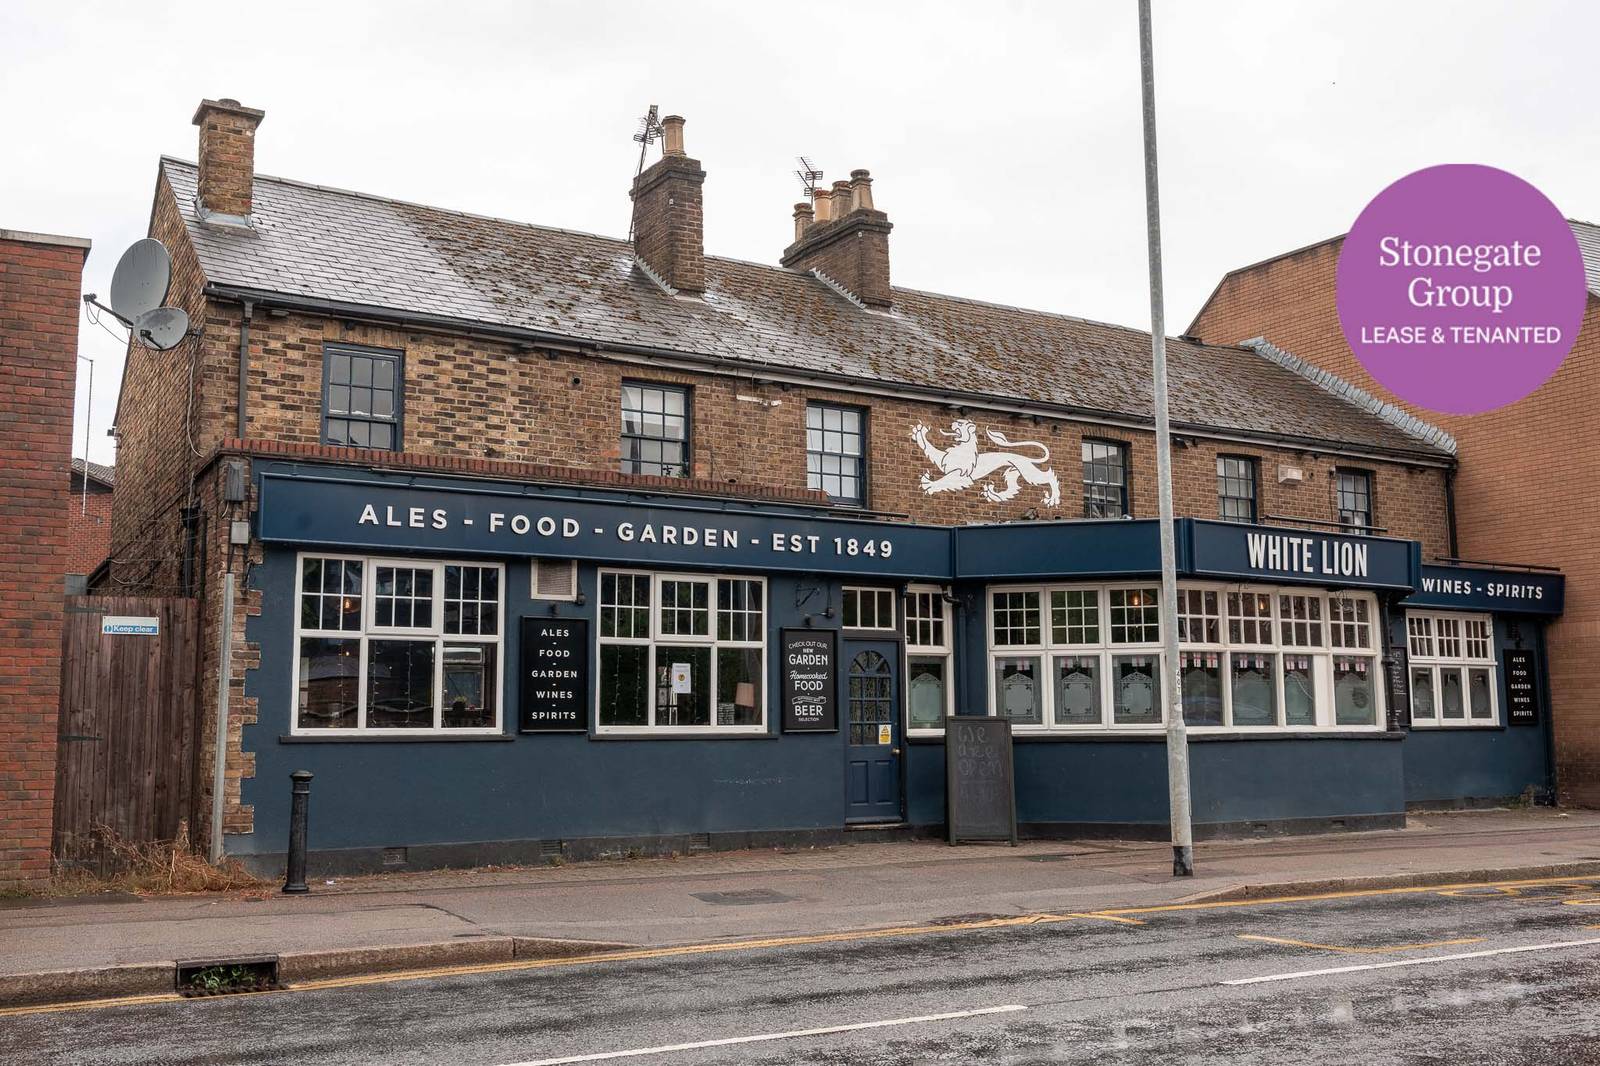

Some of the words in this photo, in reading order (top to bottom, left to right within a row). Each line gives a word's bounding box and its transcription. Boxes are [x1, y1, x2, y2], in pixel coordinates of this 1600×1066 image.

[358, 504, 448, 529] ALES
[489, 513, 580, 537] FOOD
[617, 522, 738, 548] GARDEN
[772, 533, 820, 553] EST
[834, 537, 893, 558] 1849
[1247, 533, 1314, 573] WHITE
[1321, 540, 1368, 577] LION
[1422, 578, 1472, 595] WINES
[1487, 583, 1543, 599] SPIRITS
[113, 625, 133, 633] Keep
[541, 629, 569, 637] ALES
[539, 649, 570, 657] FOOD
[788, 654, 828, 666] GARDEN
[531, 670, 578, 678] GARDEN
[794, 681, 823, 691] FOOD
[531, 711, 576, 720] SPIRITS
[794, 705, 823, 716] BEER
